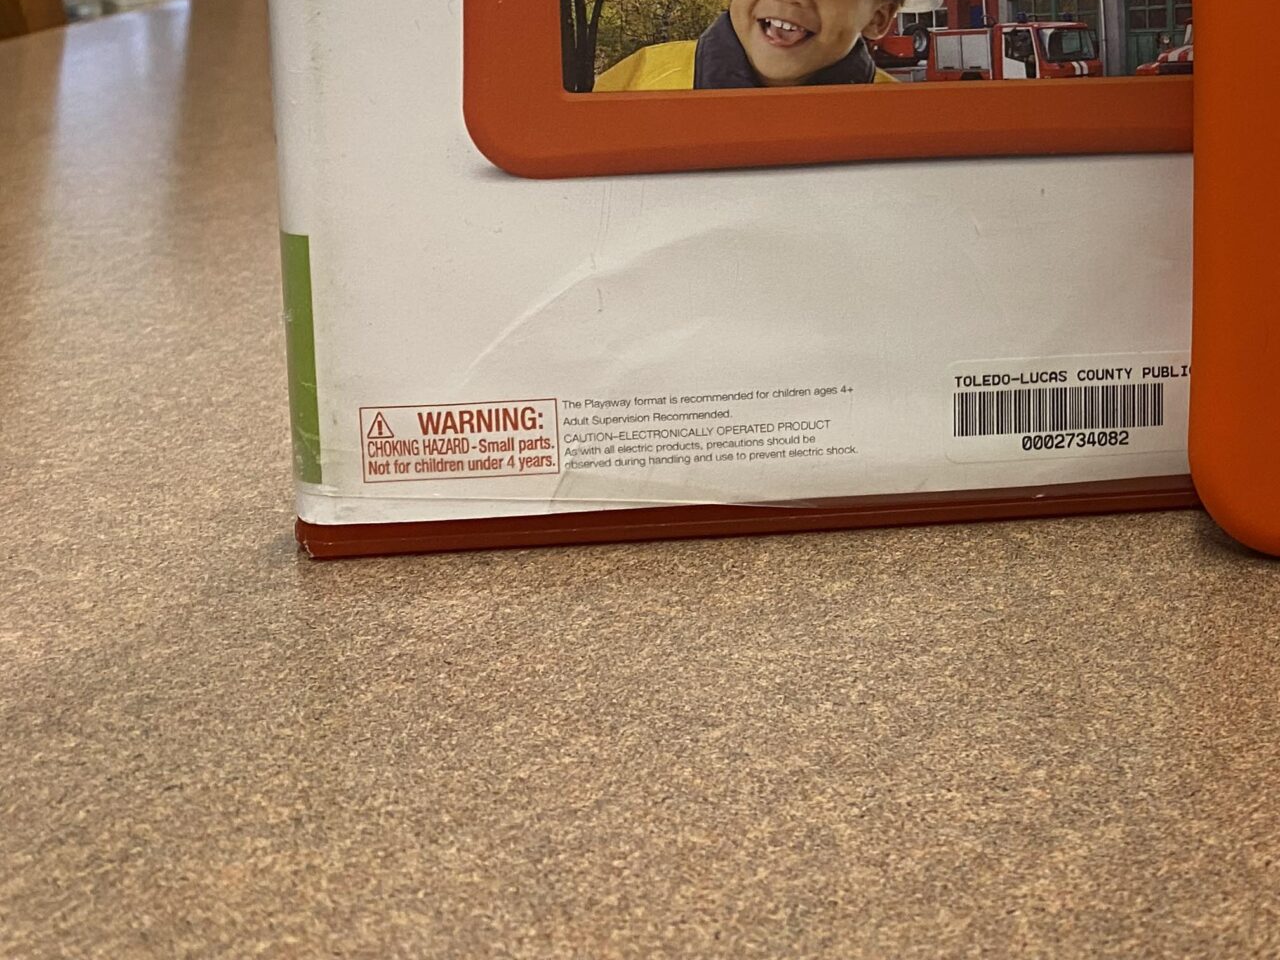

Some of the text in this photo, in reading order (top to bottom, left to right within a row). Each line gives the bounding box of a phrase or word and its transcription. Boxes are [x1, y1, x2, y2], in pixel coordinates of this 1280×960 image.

[954, 365, 1191, 388] TOLEDO-LUCAS COUNTY PUBLI
[562, 385, 854, 410] The Playaway format is recommended for children ages 4+
[417, 406, 544, 435] WARNING:
[563, 409, 733, 426] Adult Supervision Recommended.
[716, 422, 775, 436] OPERATED
[777, 419, 832, 432] PRODUCT
[367, 438, 420, 458] CHOKING
[518, 435, 555, 454] parts.
[580, 445, 602, 456] with
[604, 445, 615, 454] all
[617, 443, 653, 453] electric
[655, 441, 704, 453] products,
[706, 438, 765, 450] precautions
[767, 435, 801, 446] should
[802, 434, 816, 444] be
[1021, 430, 1130, 451] 0002734082
[368, 454, 556, 476] Not for children under 4 years.
[564, 444, 859, 470] observed during handling and use to prevent electric shock.
